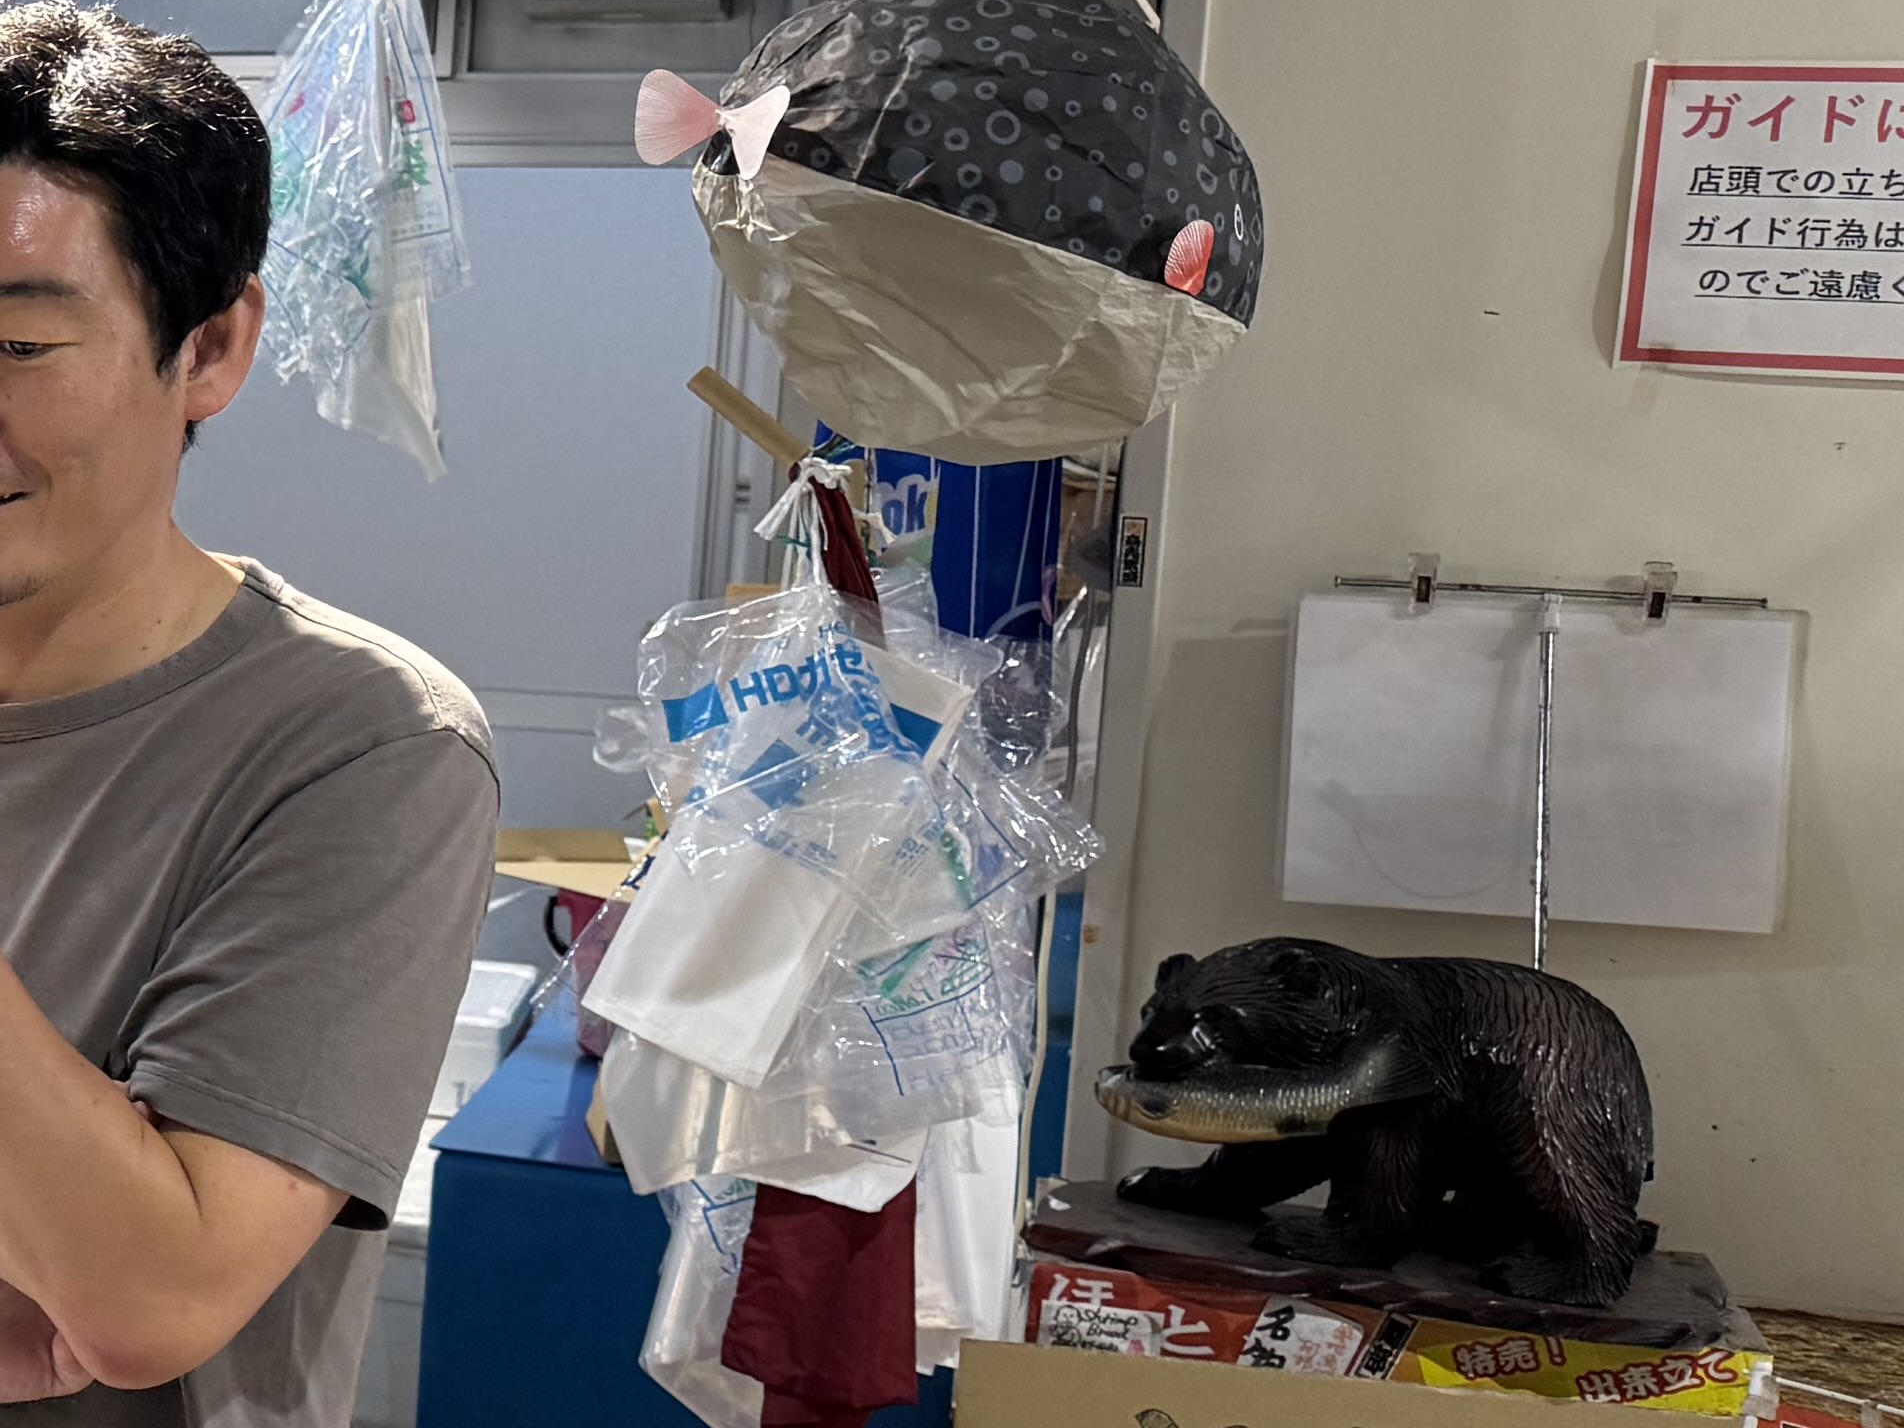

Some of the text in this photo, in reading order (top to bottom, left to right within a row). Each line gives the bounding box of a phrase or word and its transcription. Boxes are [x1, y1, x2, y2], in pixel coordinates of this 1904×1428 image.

[1689, 164, 1904, 197] 店頭での立ち
[1685, 215, 1904, 249] ガイド行為は
